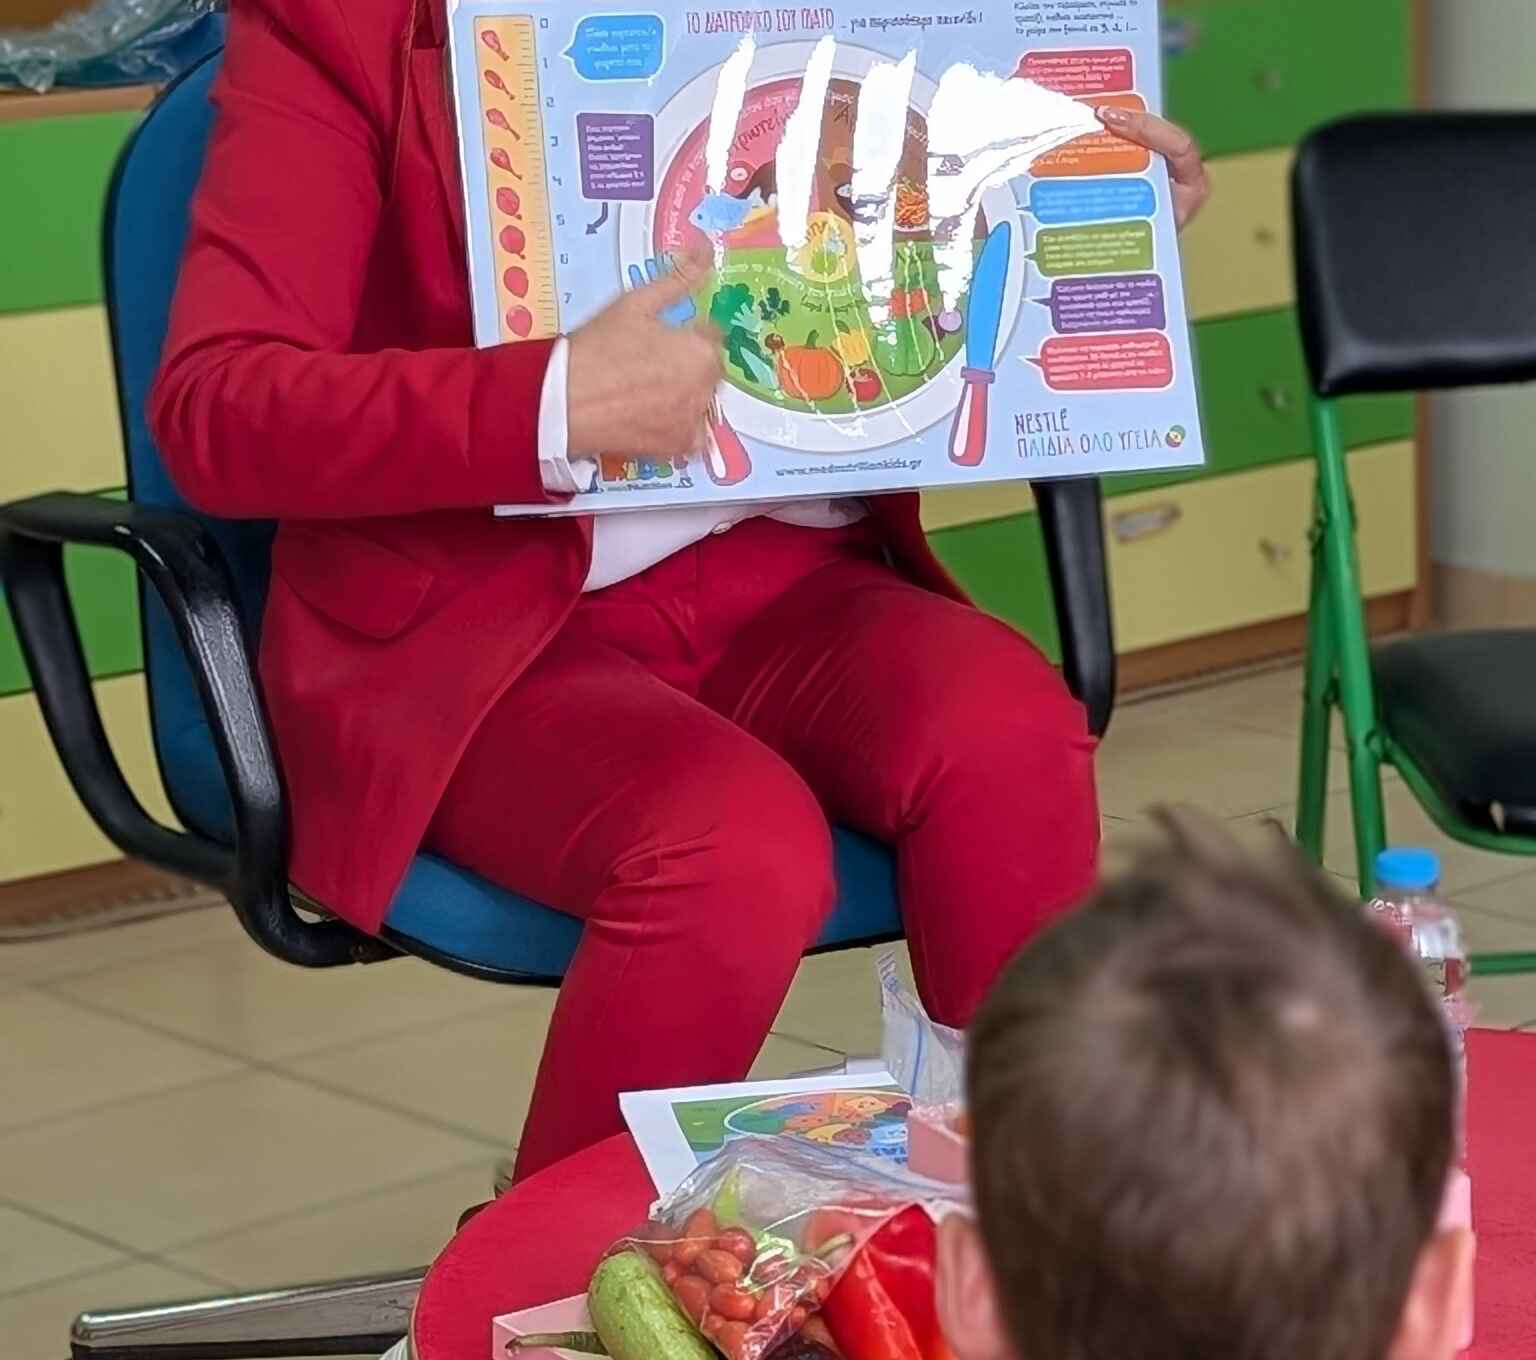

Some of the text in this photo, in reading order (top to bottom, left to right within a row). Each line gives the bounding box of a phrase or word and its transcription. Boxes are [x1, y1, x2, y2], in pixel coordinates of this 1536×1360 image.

[1016, 428, 1163, 458] ΠΑΙΔΙΑ ΟΛΟ ΥΓΕΙΑ
